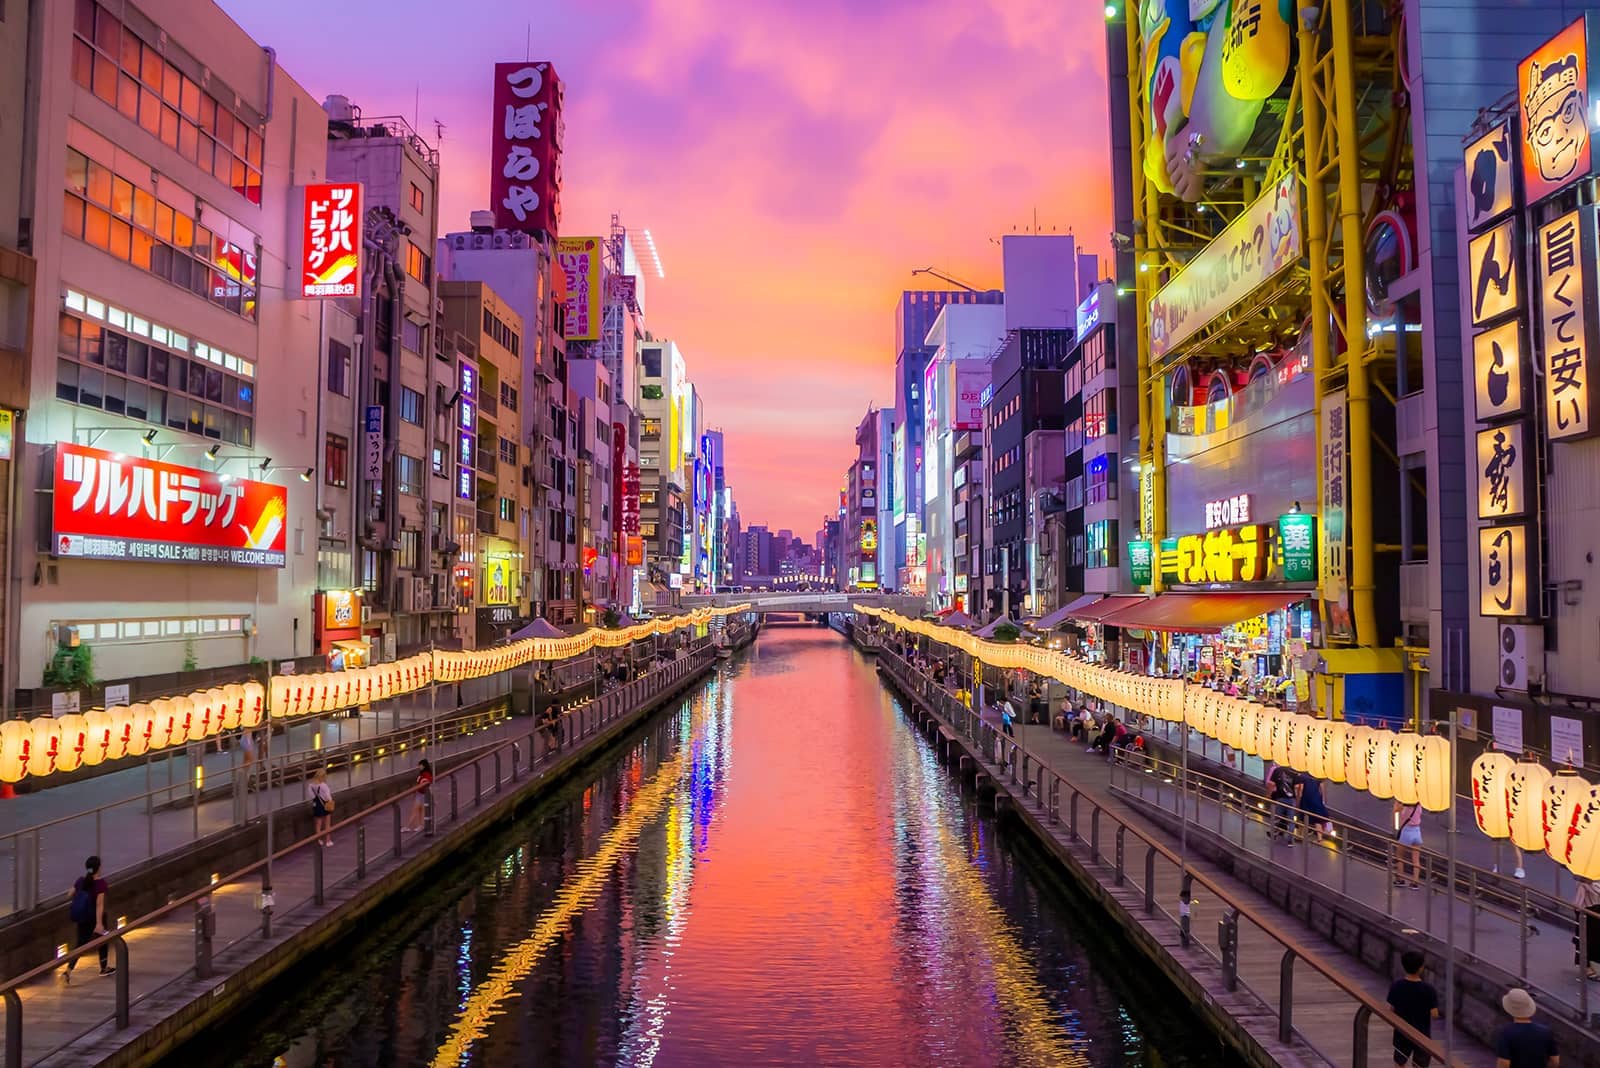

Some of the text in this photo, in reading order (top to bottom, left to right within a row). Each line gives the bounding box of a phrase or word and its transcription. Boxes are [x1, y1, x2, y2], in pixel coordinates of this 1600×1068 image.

[503, 63, 548, 222] づぼらや
[308, 200, 330, 269] ドラッグ
[329, 188, 353, 252] ツルハ
[1547, 221, 1582, 431] 旨くて安い
[63, 453, 244, 528] ツルハドラッグ
[158, 544, 181, 560] SALE
[230, 550, 265, 564] WELCOME
